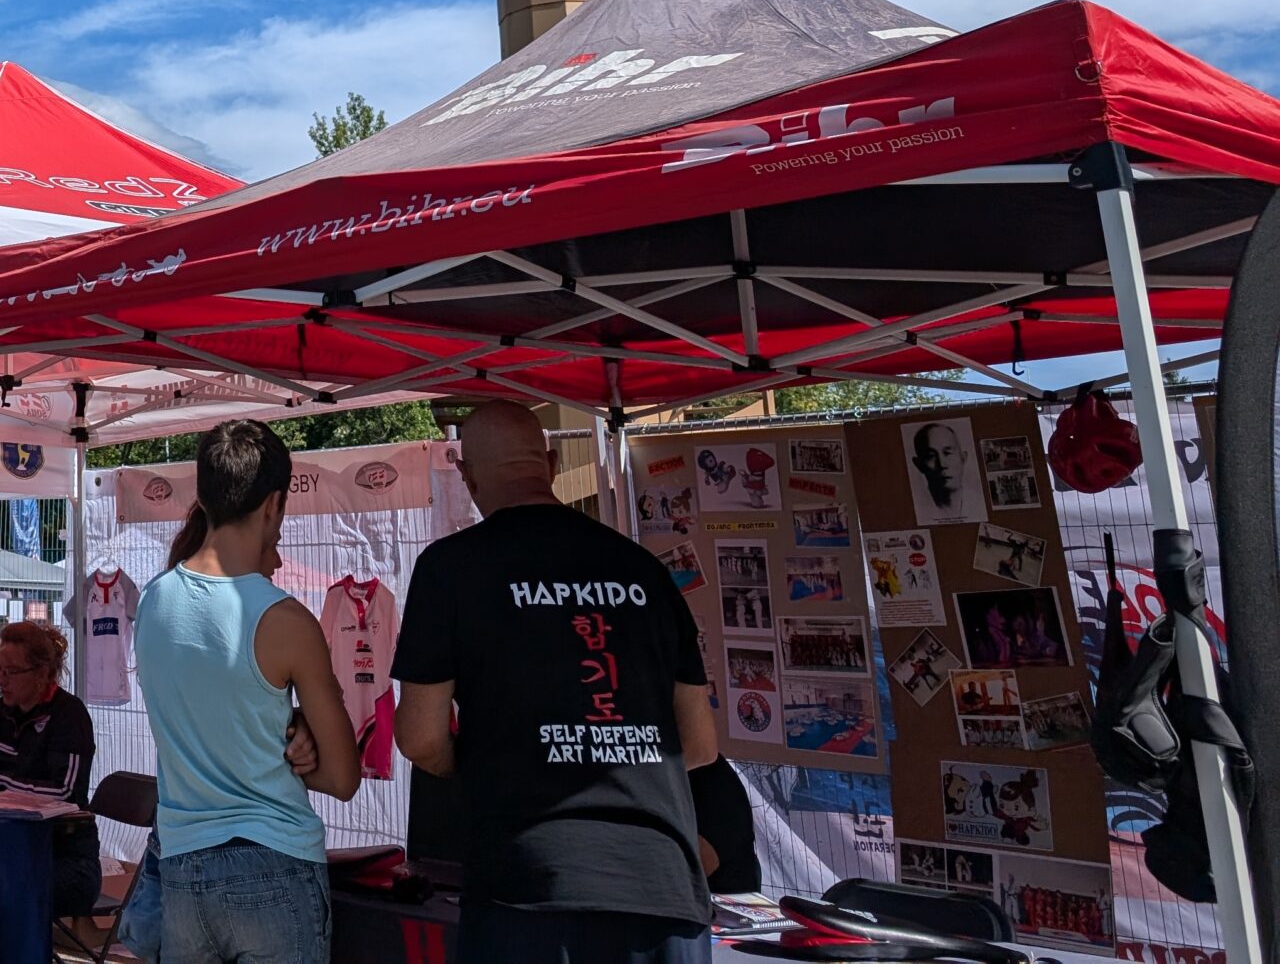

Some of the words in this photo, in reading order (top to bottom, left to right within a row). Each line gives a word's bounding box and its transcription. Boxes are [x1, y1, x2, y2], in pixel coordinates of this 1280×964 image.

[573, 92, 619, 104] your
[619, 82, 702, 98] passion
[750, 149, 837, 175] Powering
[839, 141, 884, 163] your
[888, 124, 965, 152] passion
[257, 184, 537, 256] www.bihr.eu
[289, 474, 320, 494] GBY
[510, 581, 647, 608] HAPKIDO
[571, 613, 624, 721] 합기도
[540, 724, 586, 744] SELF
[590, 725, 661, 745] DEFENSE
[546, 745, 584, 765] ART
[590, 745, 662, 766] MARTIAL
[958, 823, 998, 837] HAPKIDO
